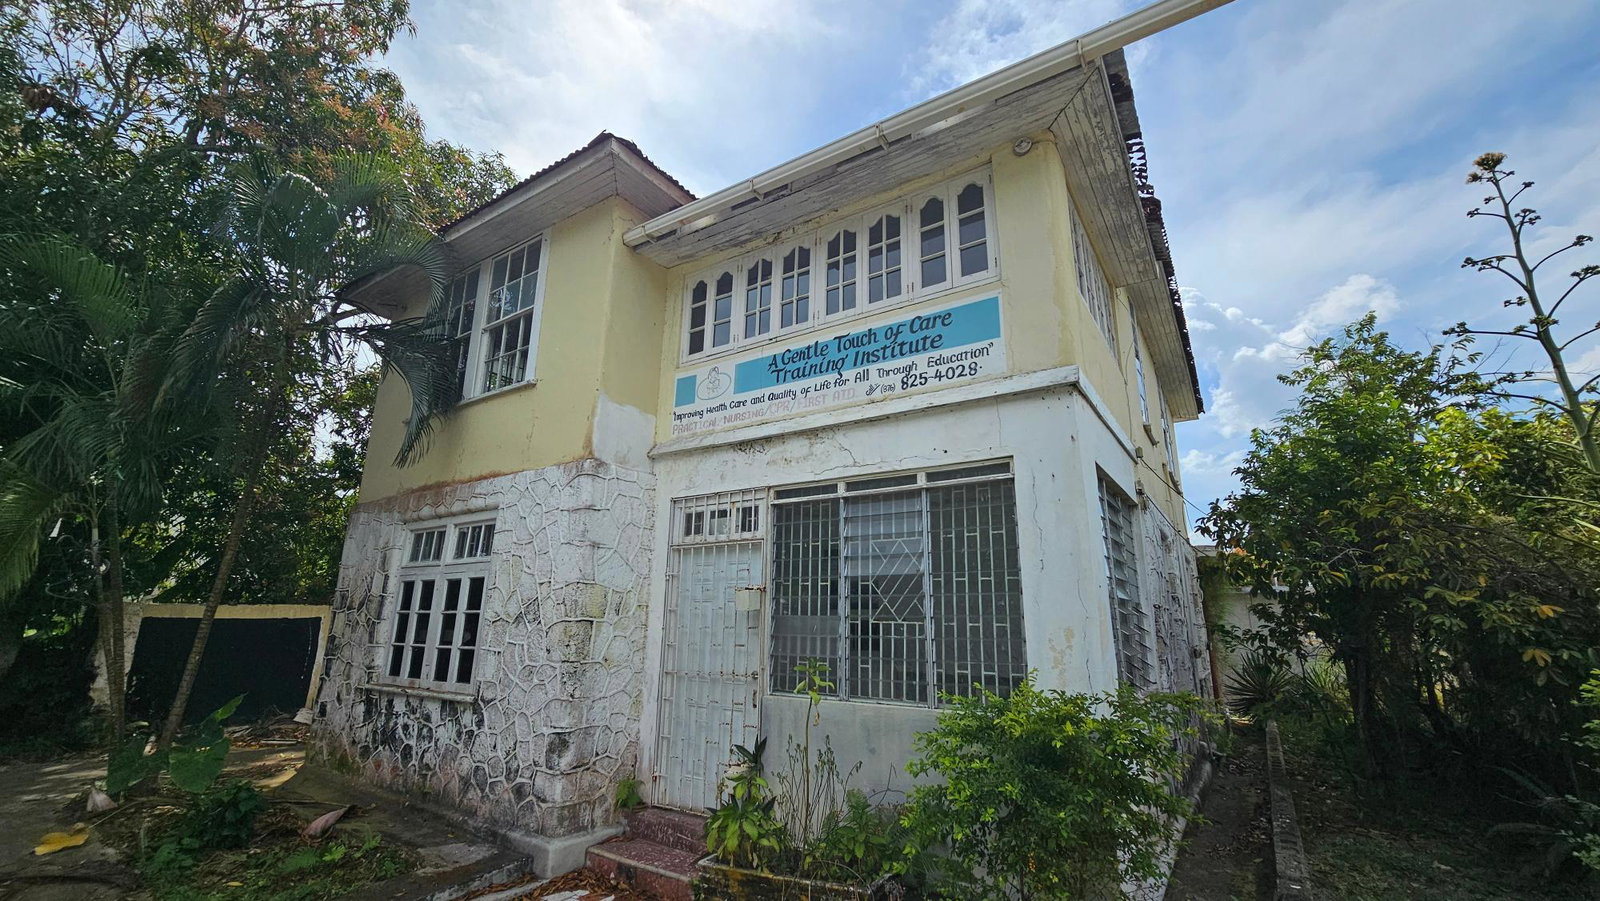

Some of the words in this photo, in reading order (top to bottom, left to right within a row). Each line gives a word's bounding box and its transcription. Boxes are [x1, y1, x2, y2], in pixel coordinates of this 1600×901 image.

[767, 355, 779, 372] A
[781, 340, 829, 365] Gentle
[833, 328, 879, 354] Touch
[884, 323, 907, 344] of
[909, 312, 954, 334] Care
[770, 354, 849, 384] Training
[853, 333, 945, 367] Institute
[706, 402, 727, 414] Health
[729, 399, 748, 409] Care
[750, 394, 765, 405] and
[767, 388, 797, 402] Quality
[800, 386, 812, 398] of
[814, 379, 831, 392] Life
[833, 377, 850, 388] for
[854, 368, 870, 383] All
[876, 360, 918, 378] Through
